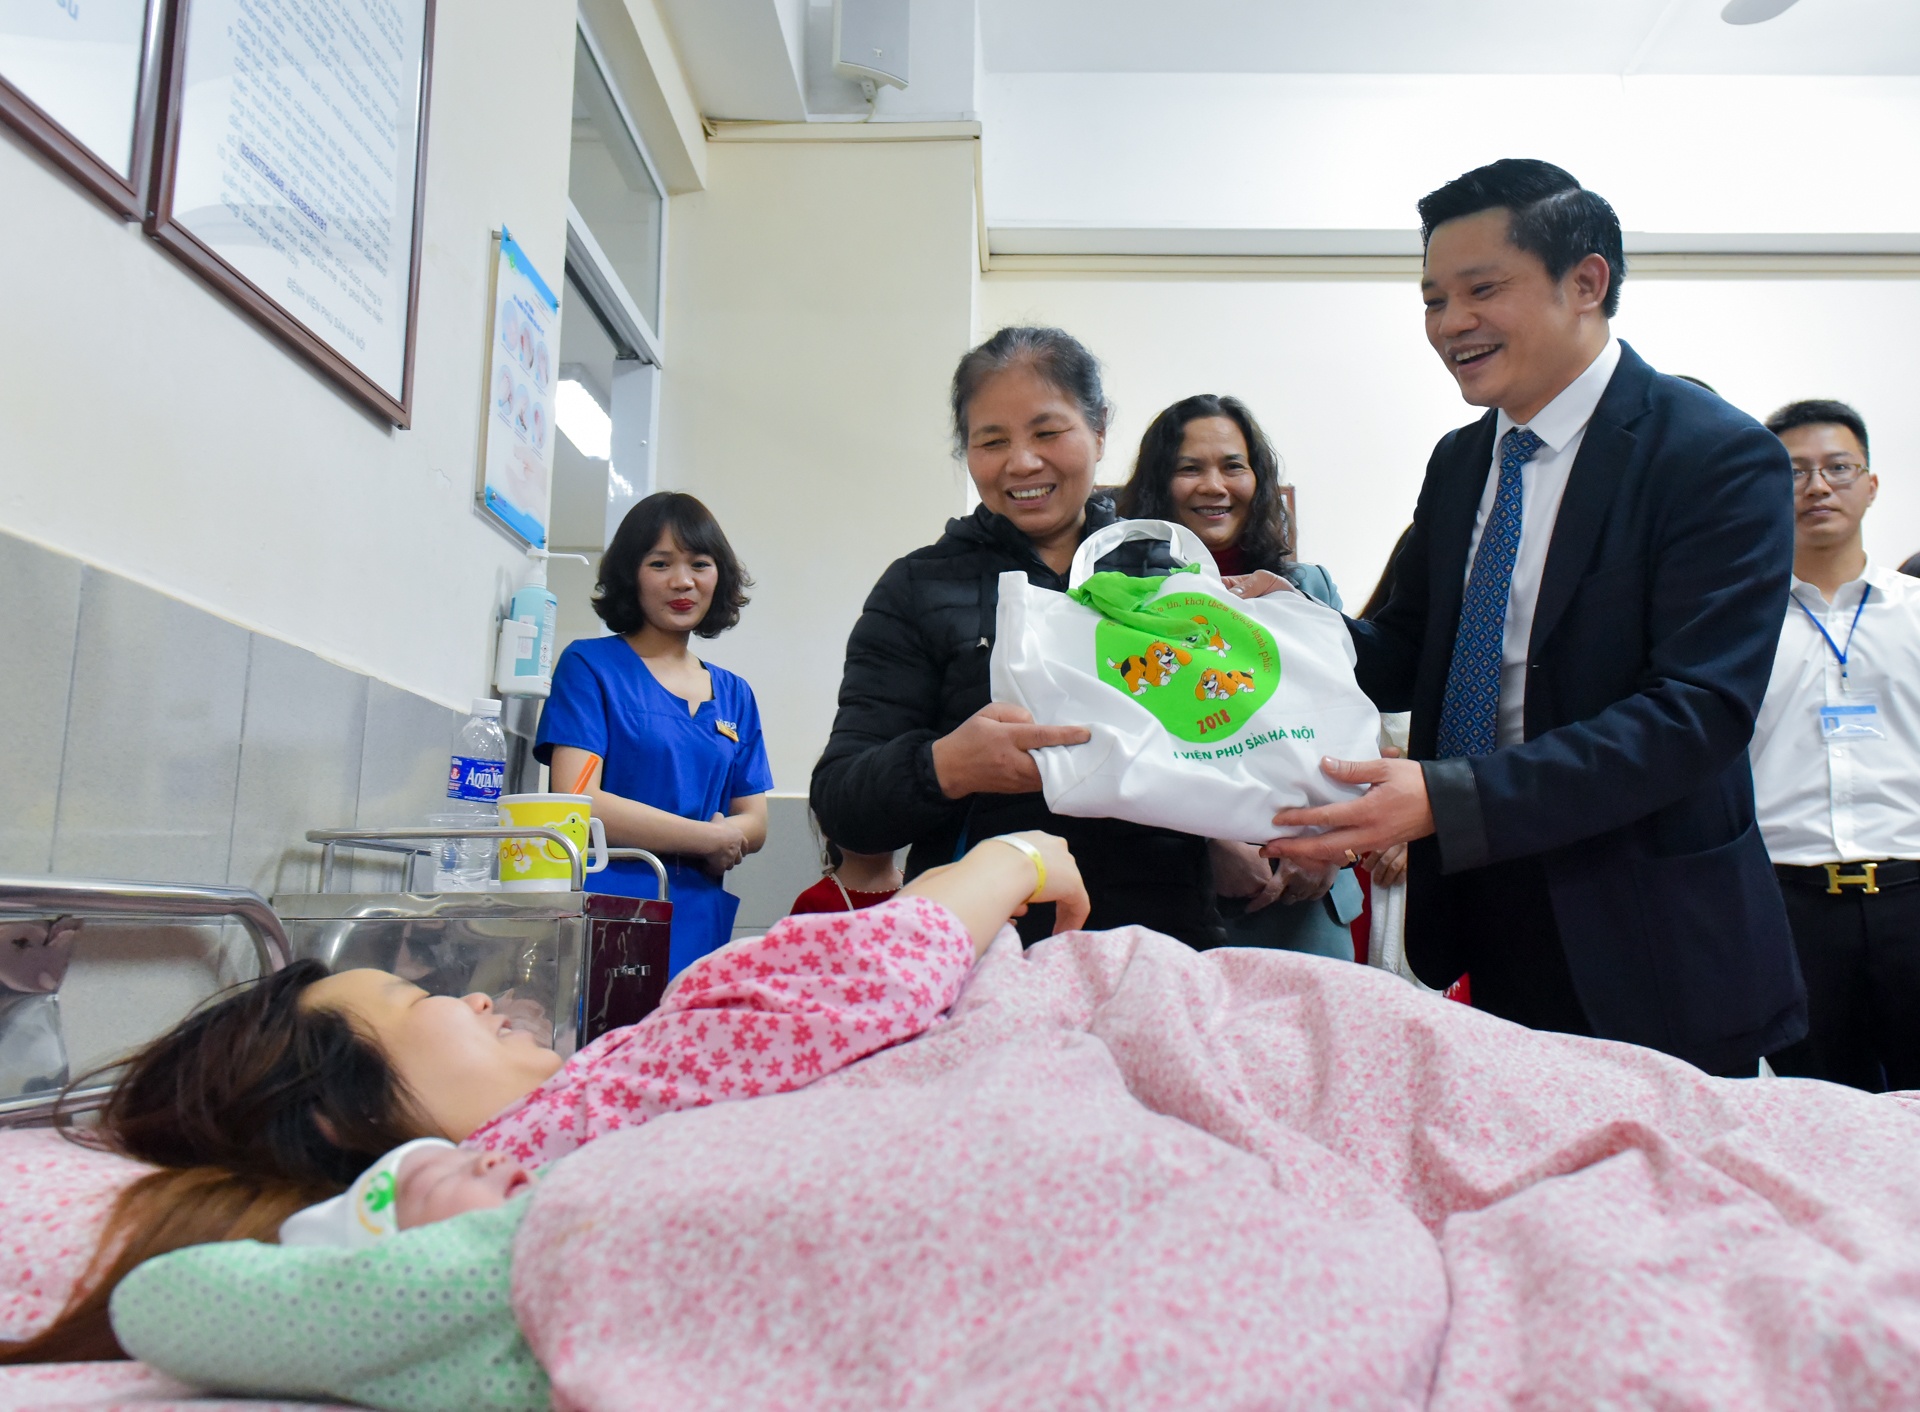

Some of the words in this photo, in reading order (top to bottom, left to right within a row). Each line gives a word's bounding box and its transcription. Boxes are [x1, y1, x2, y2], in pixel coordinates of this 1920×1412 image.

[1196, 708, 1231, 735] 2018
[1181, 749, 1213, 762] VIỆN
[1215, 742, 1244, 758] PHỤ
[1245, 732, 1269, 750] SẢN
[1267, 726, 1289, 742] HÀ
[1290, 726, 1316, 743] NỘI
